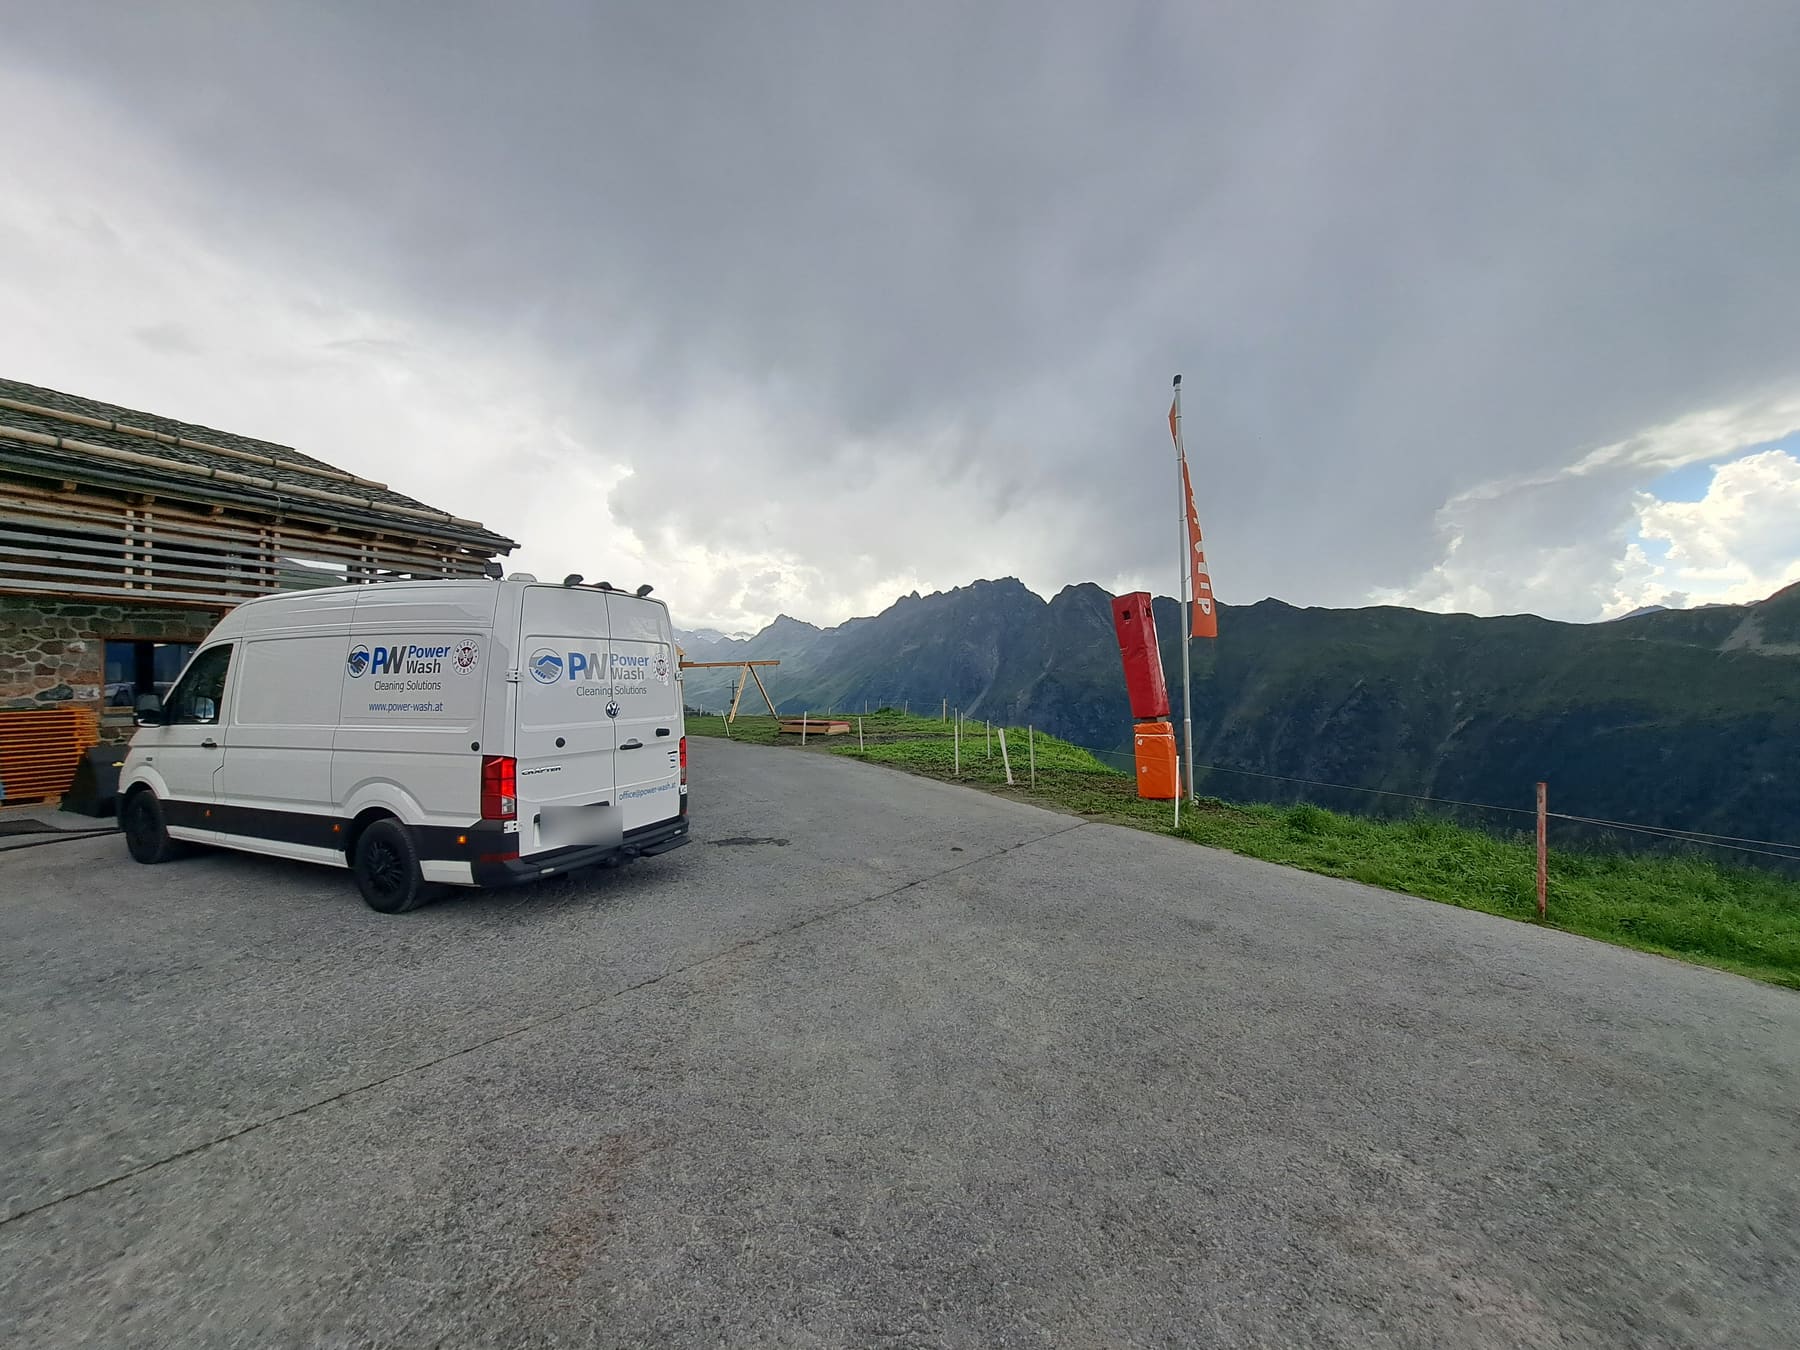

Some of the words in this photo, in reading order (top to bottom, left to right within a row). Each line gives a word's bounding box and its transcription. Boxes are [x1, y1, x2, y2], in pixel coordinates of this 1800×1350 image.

[408, 645, 451, 659] Power
[371, 646, 407, 675] PW
[406, 659, 441, 674] Wash
[568, 652, 608, 680] PW
[610, 653, 650, 667] Power
[611, 667, 645, 681] Wash
[374, 680, 405, 693] Cleaning
[406, 680, 441, 691] Solutions
[576, 685, 613, 698] Cleaning
[614, 685, 647, 696] Solutions
[369, 702, 443, 713] www.power-wash.at
[521, 765, 562, 776] CRAFTER
